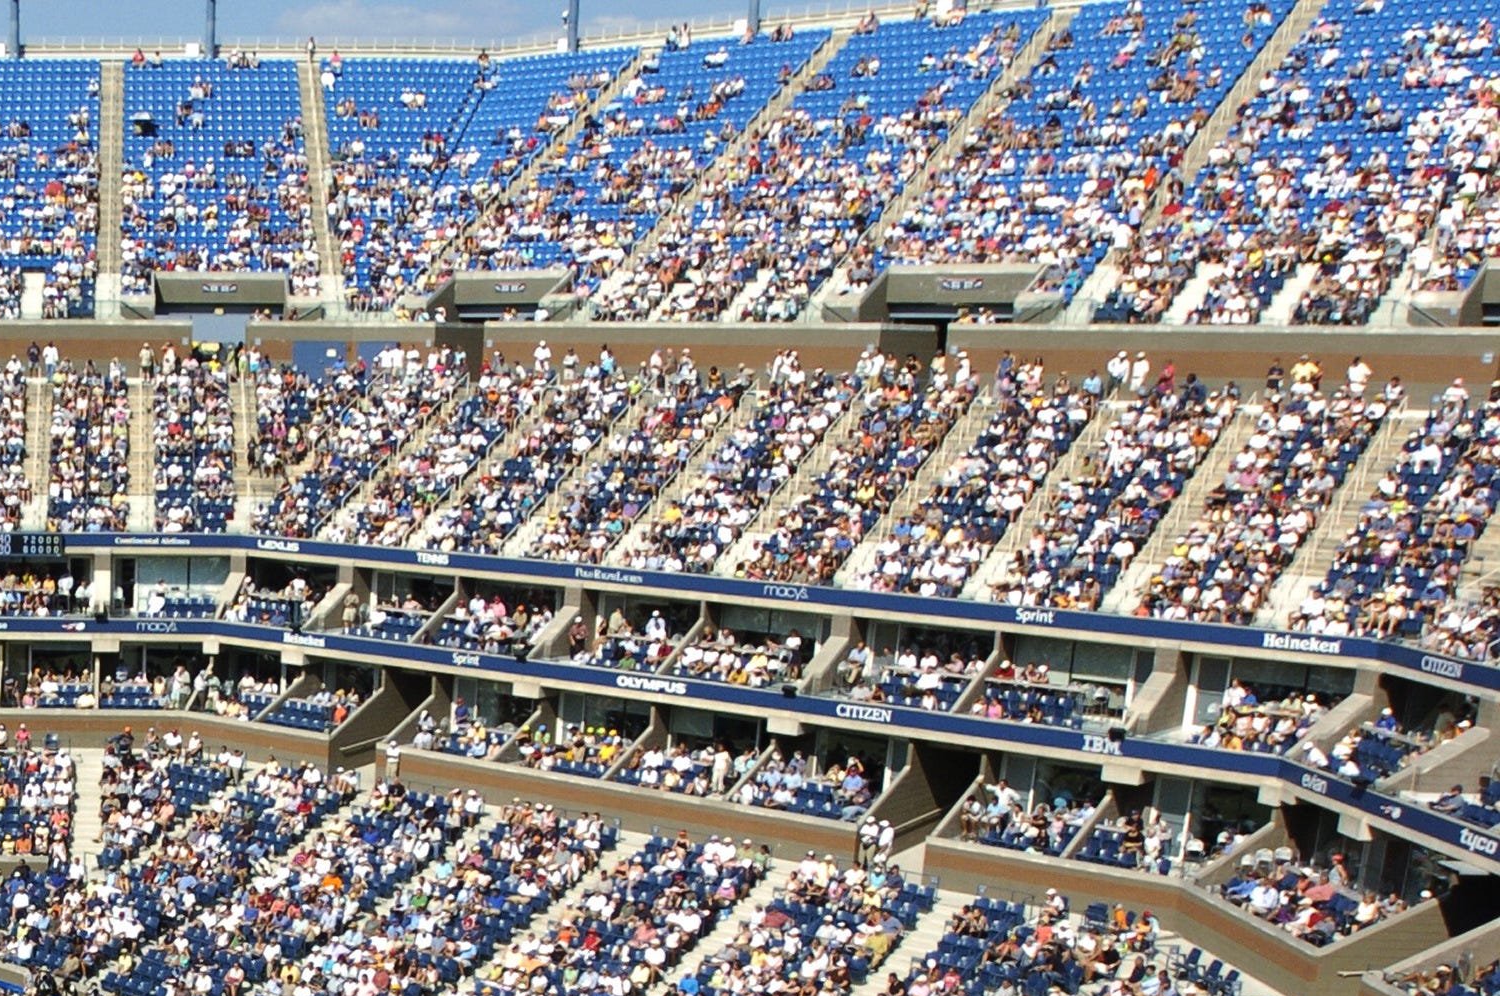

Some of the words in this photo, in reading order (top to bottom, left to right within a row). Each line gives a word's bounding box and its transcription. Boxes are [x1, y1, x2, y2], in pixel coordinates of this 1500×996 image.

[114, 537, 159, 545] Continental
[160, 537, 190, 545] Airlines
[257, 539, 300, 552] LEXUS
[416, 552, 449, 565] TENNIS
[763, 585, 809, 600] macy's
[1015, 608, 1055, 624] Sprint
[1263, 632, 1341, 654] Heineken
[452, 652, 480, 667] Sprint
[1420, 655, 1464, 679] CITIZEN
[616, 675, 687, 695] OLYMPUS
[835, 703, 892, 722] CITIZEN
[1082, 734, 1123, 755] IBM
[1459, 828, 1498, 856] tyco
